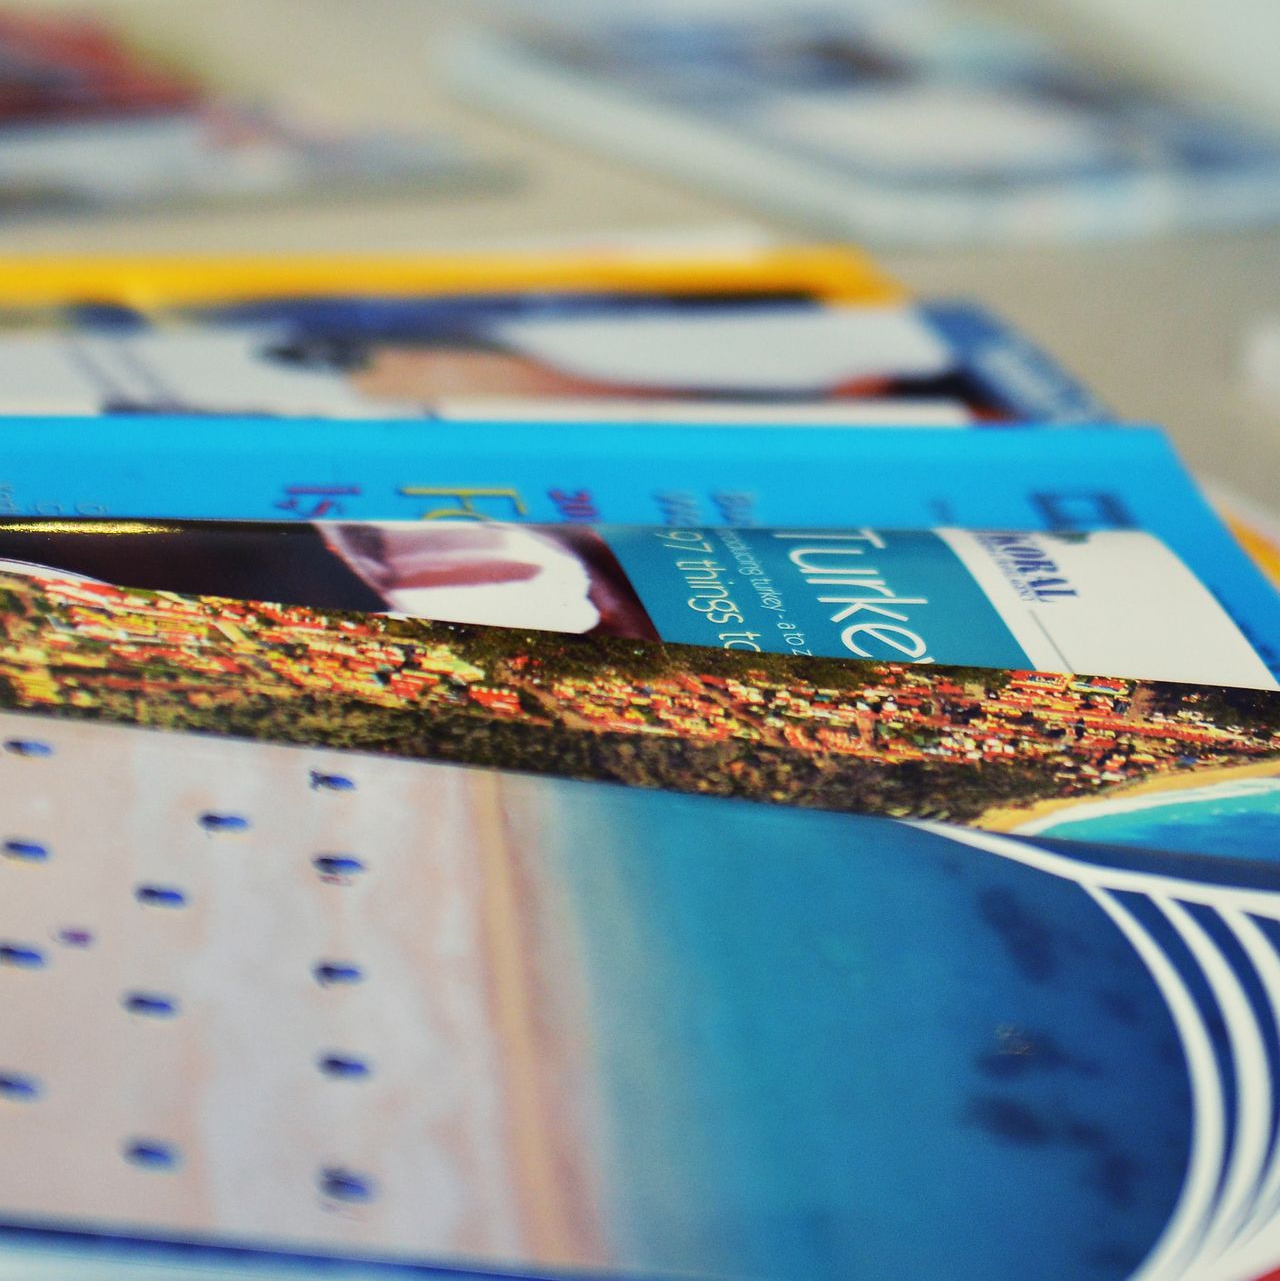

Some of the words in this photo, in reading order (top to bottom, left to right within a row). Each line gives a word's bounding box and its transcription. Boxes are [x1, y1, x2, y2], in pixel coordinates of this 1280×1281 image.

[675, 559, 745, 624] things
[751, 578, 786, 612] turkey
[773, 528, 935, 664] Turke
[777, 621, 796, 631] a
[783, 631, 805, 646] to
